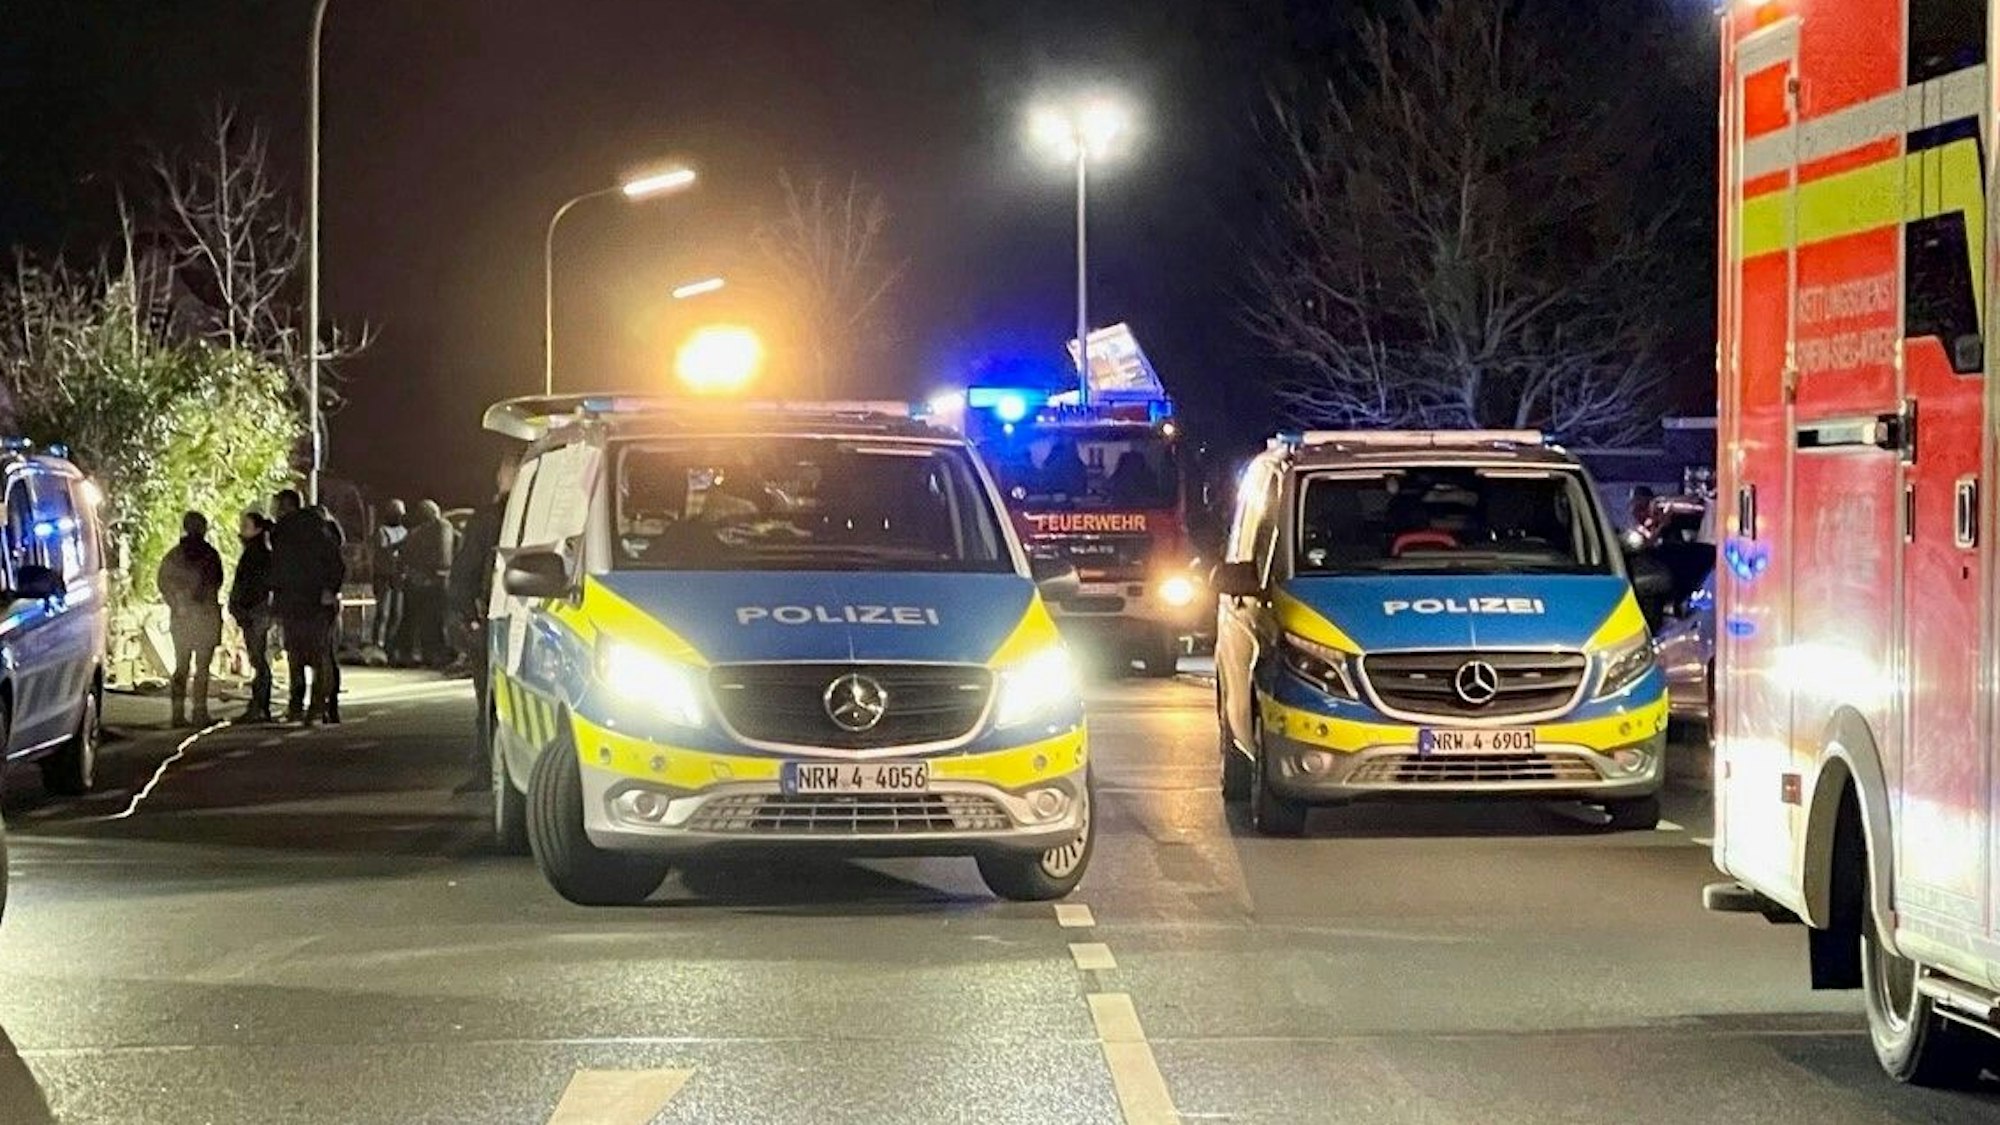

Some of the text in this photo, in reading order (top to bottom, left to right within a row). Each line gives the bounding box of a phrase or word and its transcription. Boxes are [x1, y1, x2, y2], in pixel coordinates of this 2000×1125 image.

[1037, 514, 1146, 531] FEUERWEHR
[735, 605, 939, 625] POLIZEI
[1383, 598, 1545, 616] POLIZEI
[1433, 733, 1463, 750] NRW
[799, 767, 838, 789] NRW
